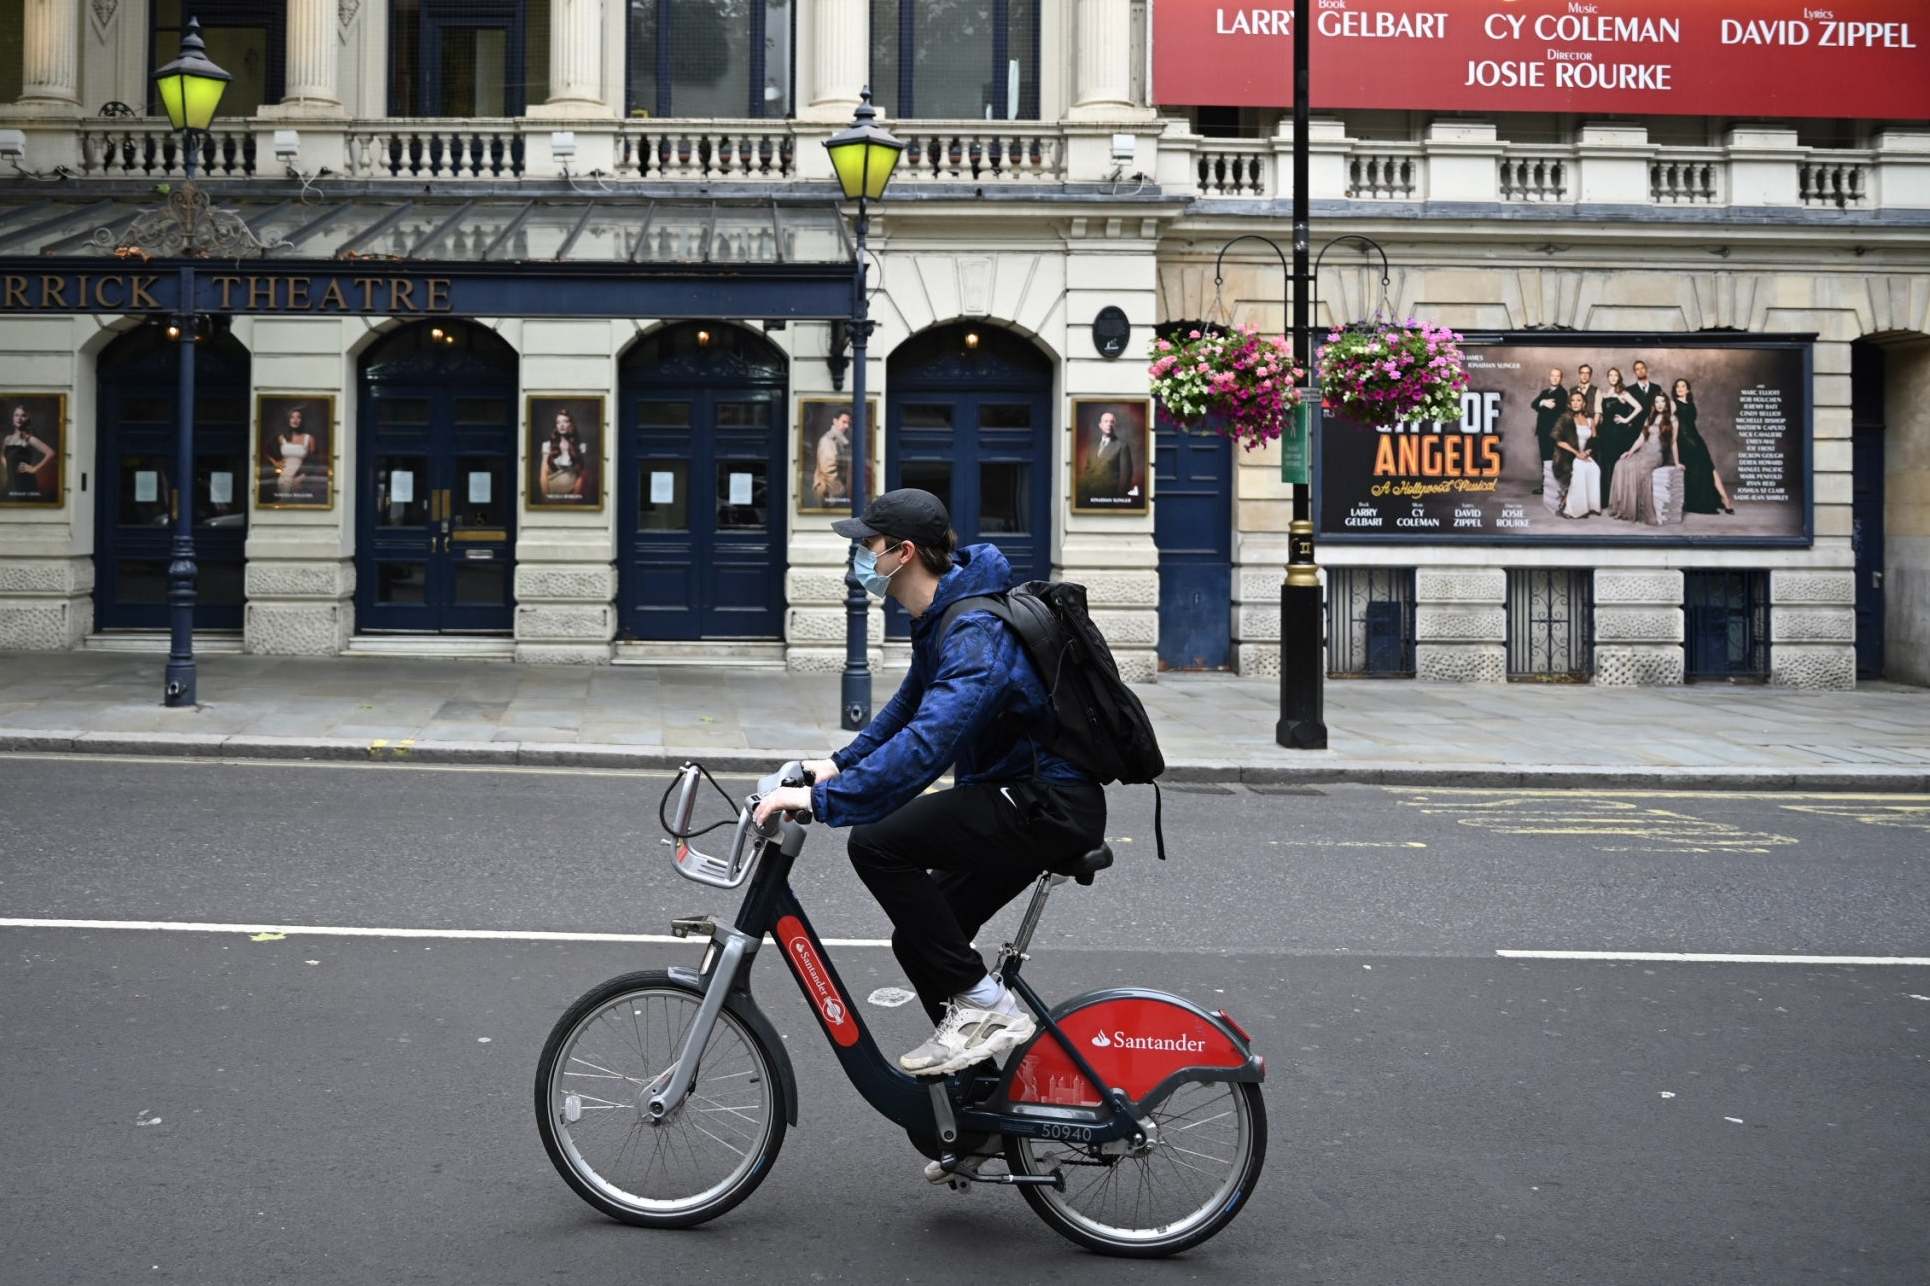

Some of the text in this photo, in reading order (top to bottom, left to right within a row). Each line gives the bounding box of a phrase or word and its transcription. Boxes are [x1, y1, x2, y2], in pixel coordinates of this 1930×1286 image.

[1568, 2, 1598, 14] Music
[1803, 7, 1834, 20] Lyrics
[1216, 8, 1449, 38] LARR GELBART
[1484, 13, 1680, 43] CY COLEMAN
[1720, 19, 1917, 48] DAVID ZIPPEL
[1464, 60, 1672, 90] JOSIE ROURKE
[211, 275, 454, 311] THEATRE
[1459, 392, 1501, 434] OF
[1373, 434, 1501, 477] ANGELS
[1392, 479, 1454, 500] Hollywood
[1454, 477, 1498, 493] Musical
[1345, 517, 1383, 526] GELBART
[1350, 508, 1378, 517] LARRY
[1396, 518, 1440, 527] COLEMAN
[1411, 508, 1425, 517] CY
[1453, 518, 1483, 527] ZIPPEL
[1455, 509, 1481, 517] DAVID
[1501, 509, 1524, 518] JOSIE
[801, 951, 828, 996] Santander
[1113, 1030, 1206, 1052] Santander
[1041, 1123, 1092, 1142] 50940
